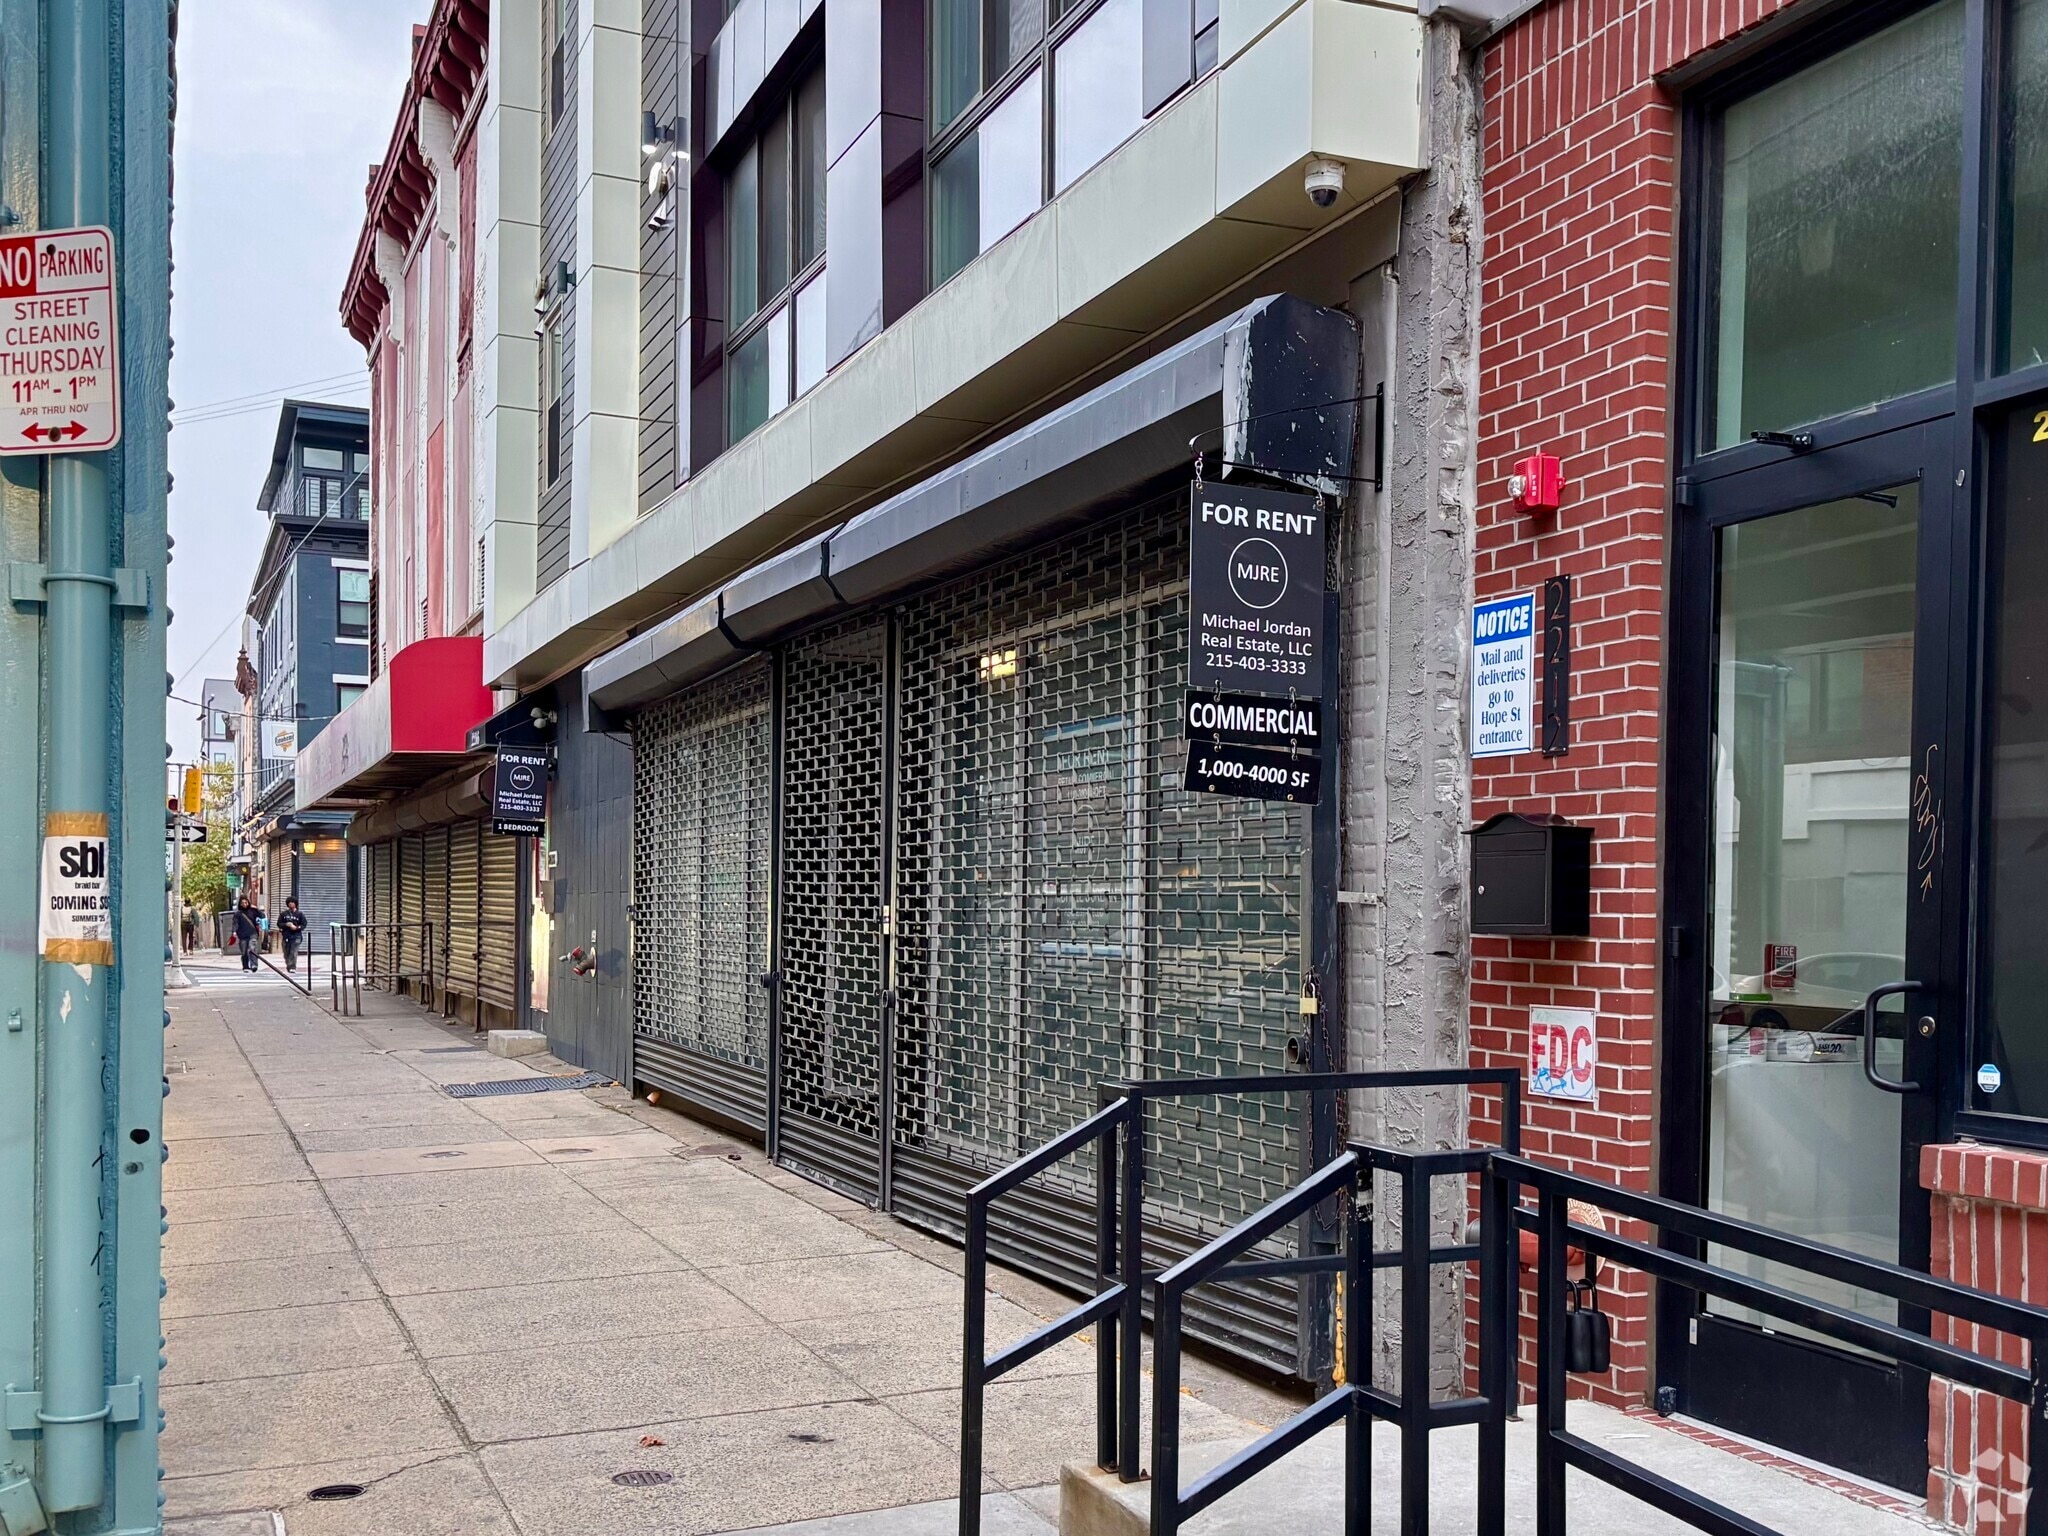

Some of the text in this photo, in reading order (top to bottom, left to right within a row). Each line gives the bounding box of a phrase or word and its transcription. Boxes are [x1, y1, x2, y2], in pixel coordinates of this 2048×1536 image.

[0, 246, 103, 288] NO PARKING
[15, 297, 89, 320] STREET
[6, 321, 100, 346] CLEANING
[0, 345, 105, 376] THURSDAY
[20, 403, 89, 416] APR THRU NOV
[2033, 410, 2048, 442] 2
[1202, 502, 1317, 535] FOR RENT
[1237, 562, 1280, 583] MJRE
[1202, 613, 1311, 637] Michael Jordan
[1476, 605, 1530, 638] NOTICE
[1201, 632, 1312, 657] Real Estate, LLC
[1206, 653, 1307, 675] 215-403-3333
[1480, 645, 1523, 667] Mail and
[1477, 667, 1526, 687] deliveries
[1488, 689, 1514, 709] go to
[1190, 702, 1317, 736] COMMERCIAL
[1481, 706, 1521, 728] Hope St
[1479, 729, 1523, 746] entrance
[501, 754, 546, 766] FOR RENT
[513, 774, 531, 782] MJRE
[1198, 758, 1310, 788] 1,000-4000 SF
[499, 790, 522, 799] Michael
[512, 799, 532, 807] Estate,
[500, 803, 540, 813] 215-403-3333
[503, 824, 539, 833] BEDROOM
[51, 895, 97, 911] COMING
[71, 915, 98, 923] SUMMER
[1774, 946, 1795, 956] FIRE
[1532, 1023, 1592, 1083] FDC
